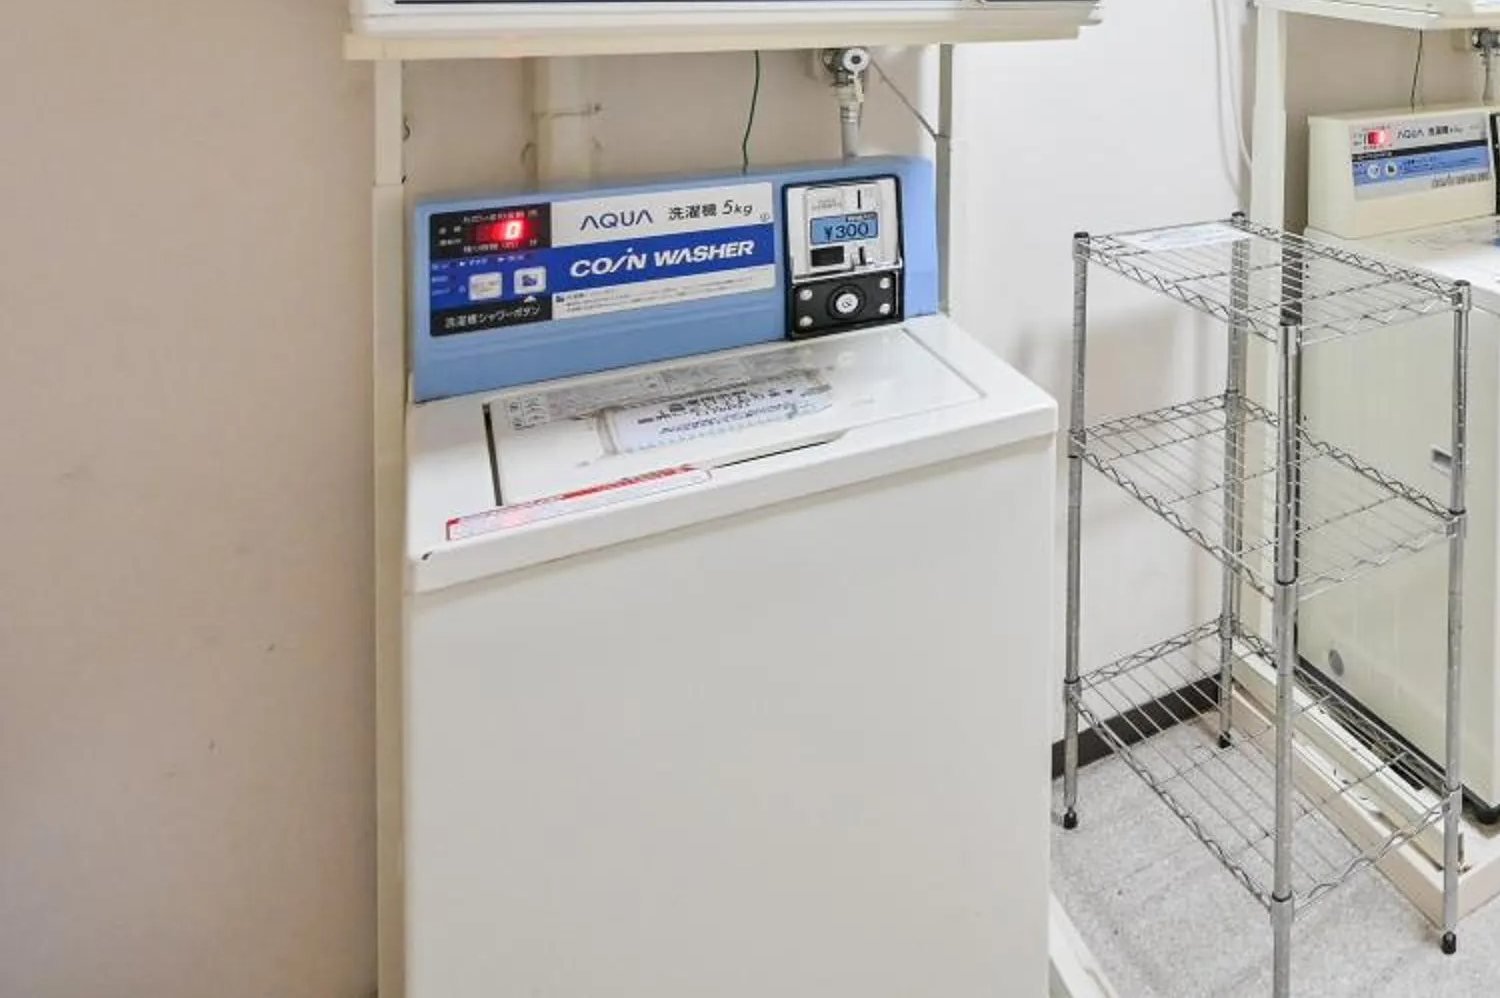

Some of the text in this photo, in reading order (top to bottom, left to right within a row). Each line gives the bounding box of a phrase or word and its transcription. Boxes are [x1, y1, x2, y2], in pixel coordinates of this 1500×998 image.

[580, 209, 653, 231] AQUA
[667, 200, 753, 221] 洗濯機 5kg
[654, 239, 755, 267] WASHER
